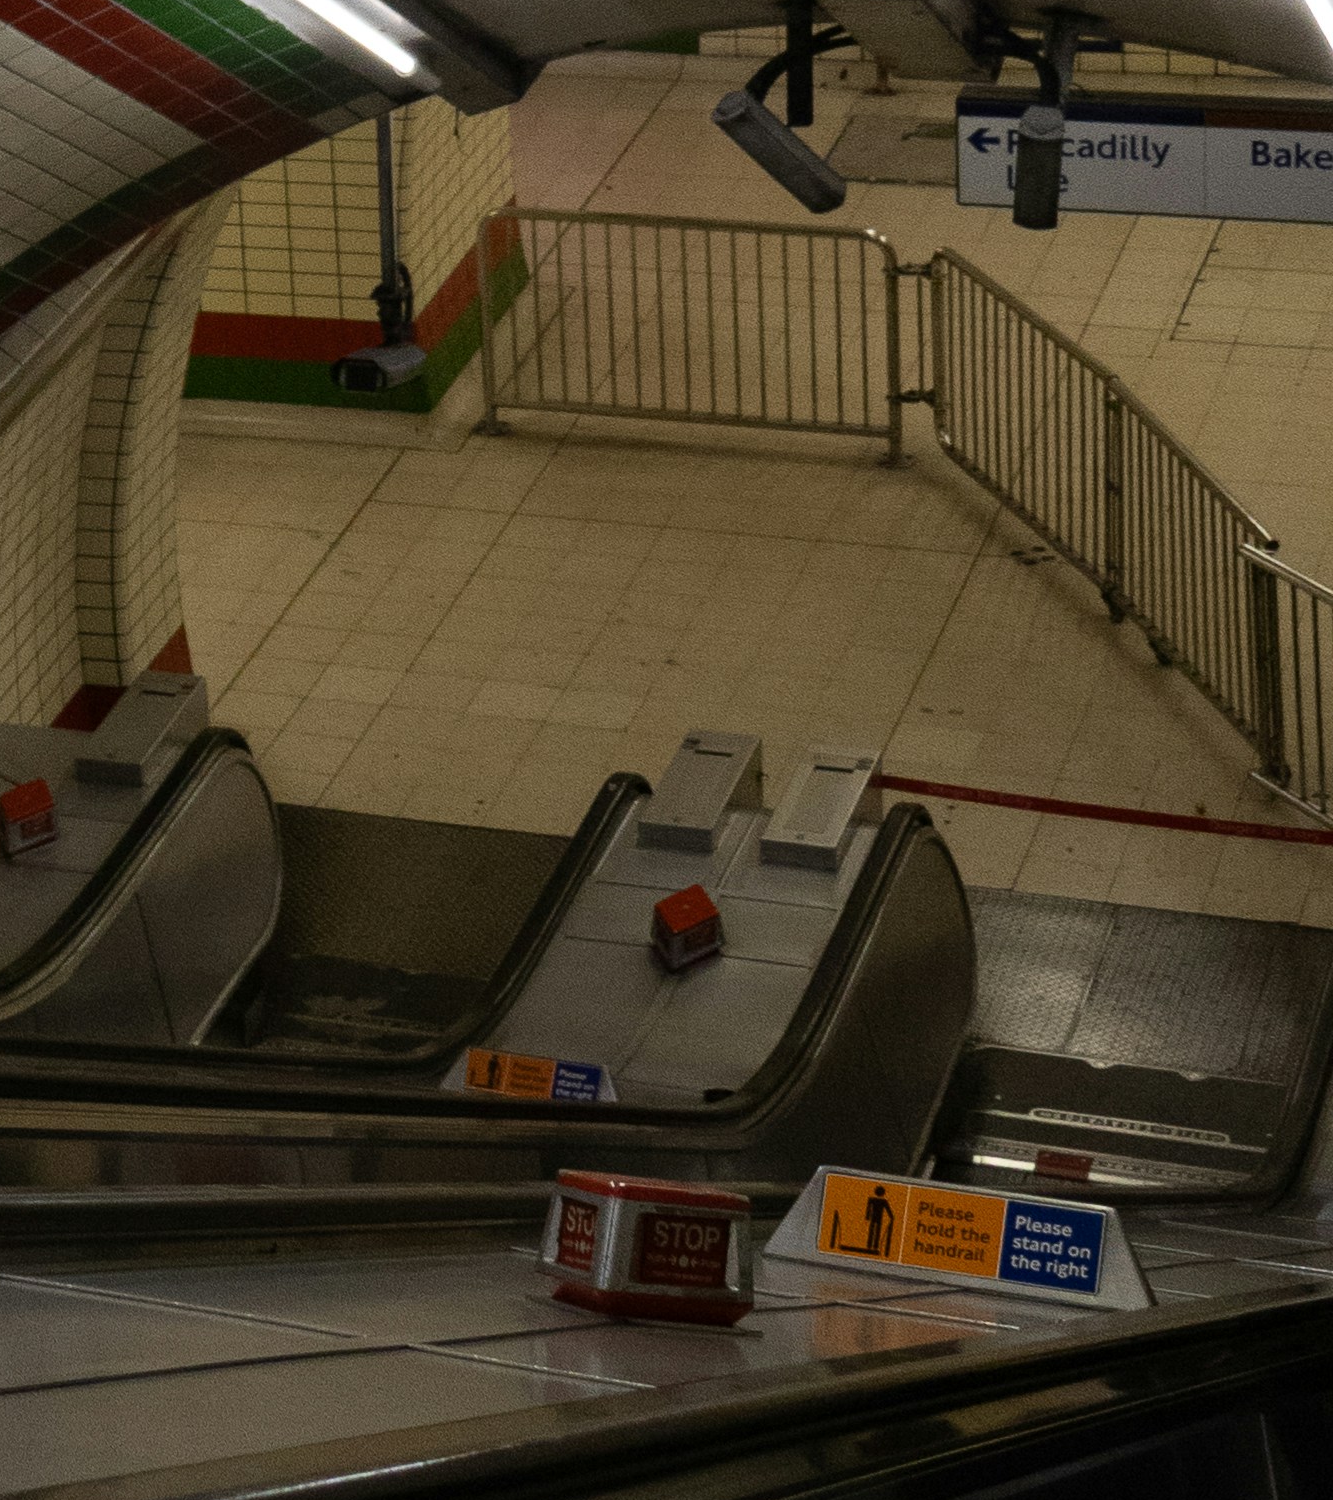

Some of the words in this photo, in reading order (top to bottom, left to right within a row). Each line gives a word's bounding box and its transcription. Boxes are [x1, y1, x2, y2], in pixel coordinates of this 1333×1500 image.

[1007, 129, 1171, 168] Pcadilly
[1007, 164, 1069, 193] Le
[917, 1201, 975, 1222] Please
[654, 1220, 721, 1251] STOP
[916, 1220, 955, 1239] hold
[960, 1226, 991, 1244] the
[1014, 1214, 1074, 1237] Please
[914, 1239, 985, 1262] handrail
[1012, 1236, 1064, 1256] stand
[1067, 1245, 1092, 1260] on
[1009, 1253, 1042, 1272] the
[1045, 1258, 1090, 1279] right
